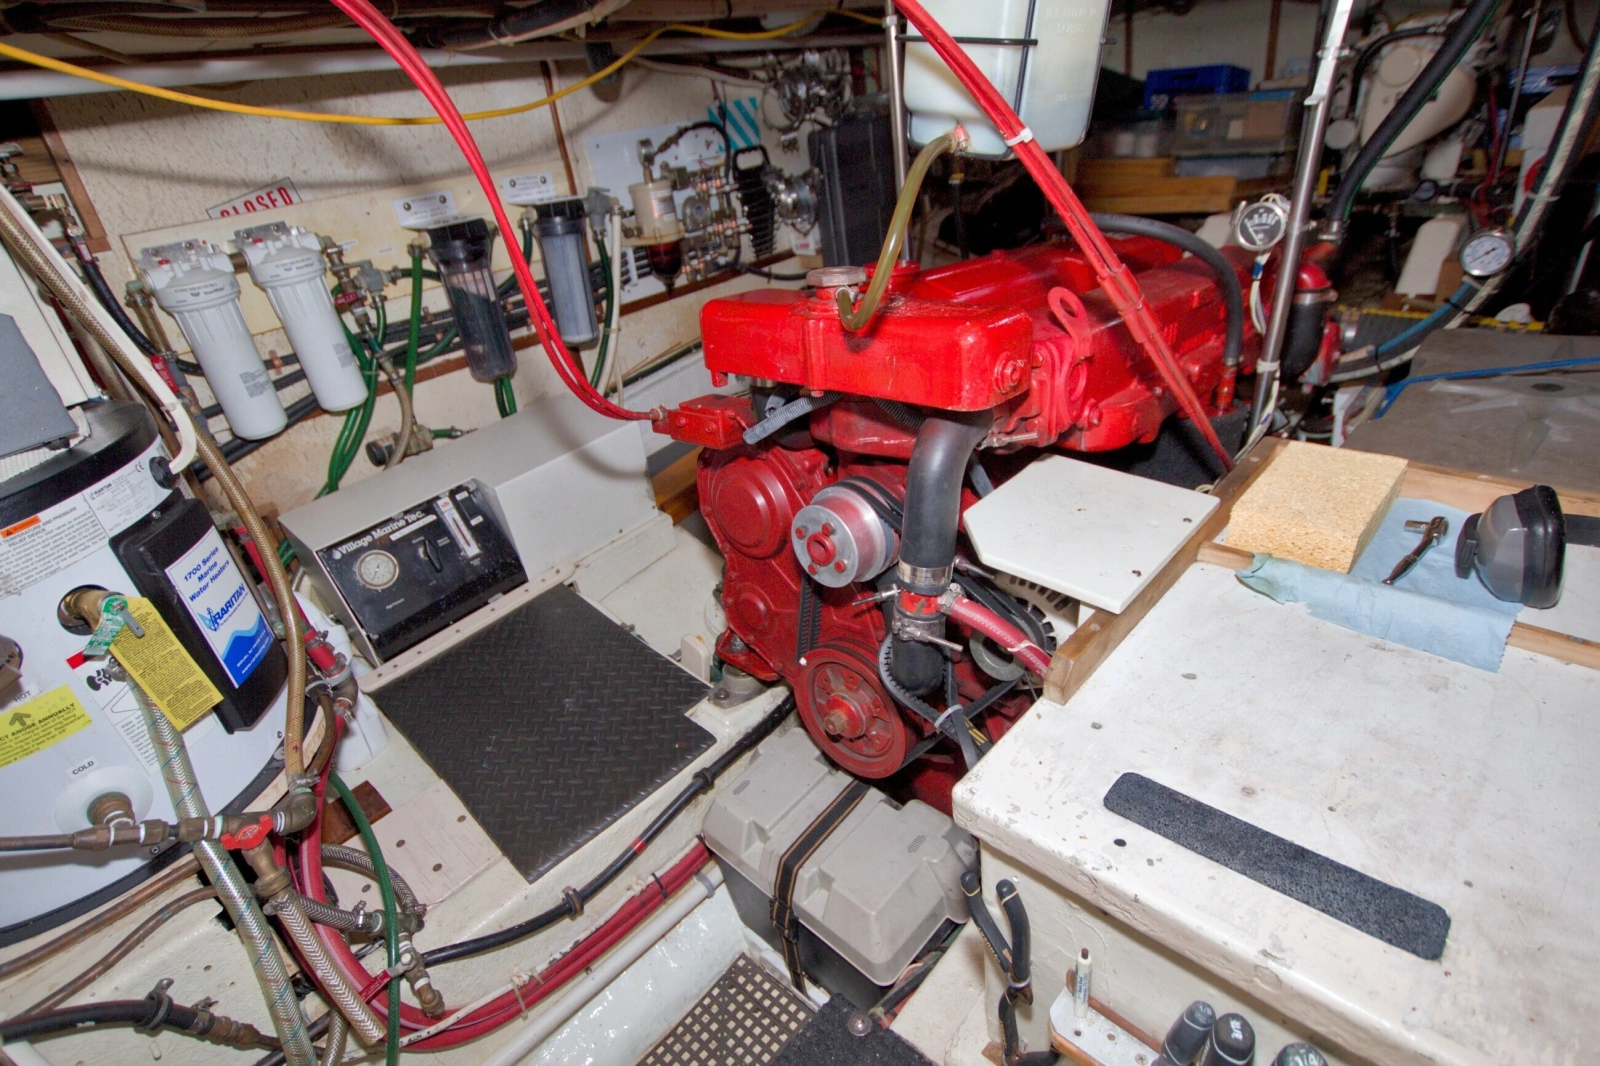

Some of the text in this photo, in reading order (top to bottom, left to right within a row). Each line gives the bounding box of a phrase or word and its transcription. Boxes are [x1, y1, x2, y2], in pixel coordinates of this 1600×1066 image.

[3, 505, 77, 544] TEMPERATURE AND PRESSURE
[7, 526, 46, 548] RELIEF DEVICE
[339, 533, 373, 555] Village
[371, 518, 406, 540] Marine
[404, 511, 424, 523] Tec.
[182, 545, 220, 582] 1700 Series
[188, 559, 231, 602] Water Heaters
[196, 560, 218, 583] Marine
[213, 583, 247, 623] RARITAN
[13, 690, 31, 702] HOT
[10, 721, 36, 736] ANODE
[37, 702, 75, 724] ANNUALLY
[72, 761, 95, 776] COLD
